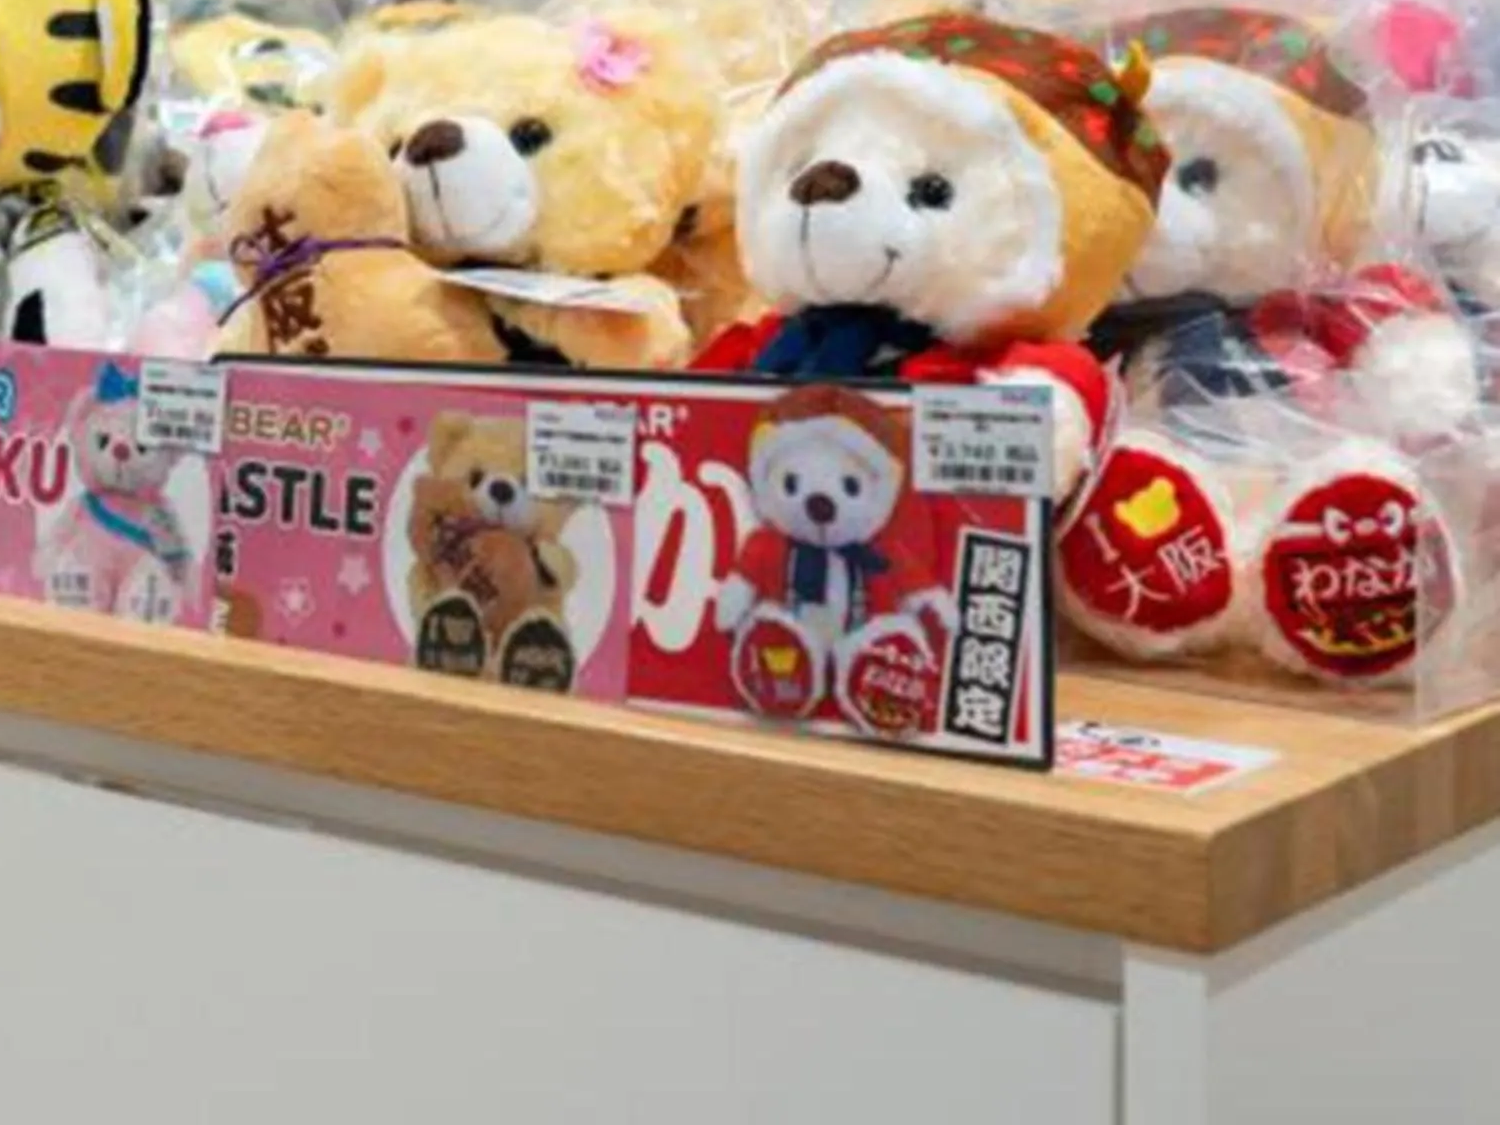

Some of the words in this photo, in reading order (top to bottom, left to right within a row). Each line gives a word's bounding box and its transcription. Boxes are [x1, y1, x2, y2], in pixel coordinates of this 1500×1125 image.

[229, 405, 334, 446] BEAR
[1105, 523, 1224, 620] 大阪
[953, 542, 1025, 739] 関西限定
